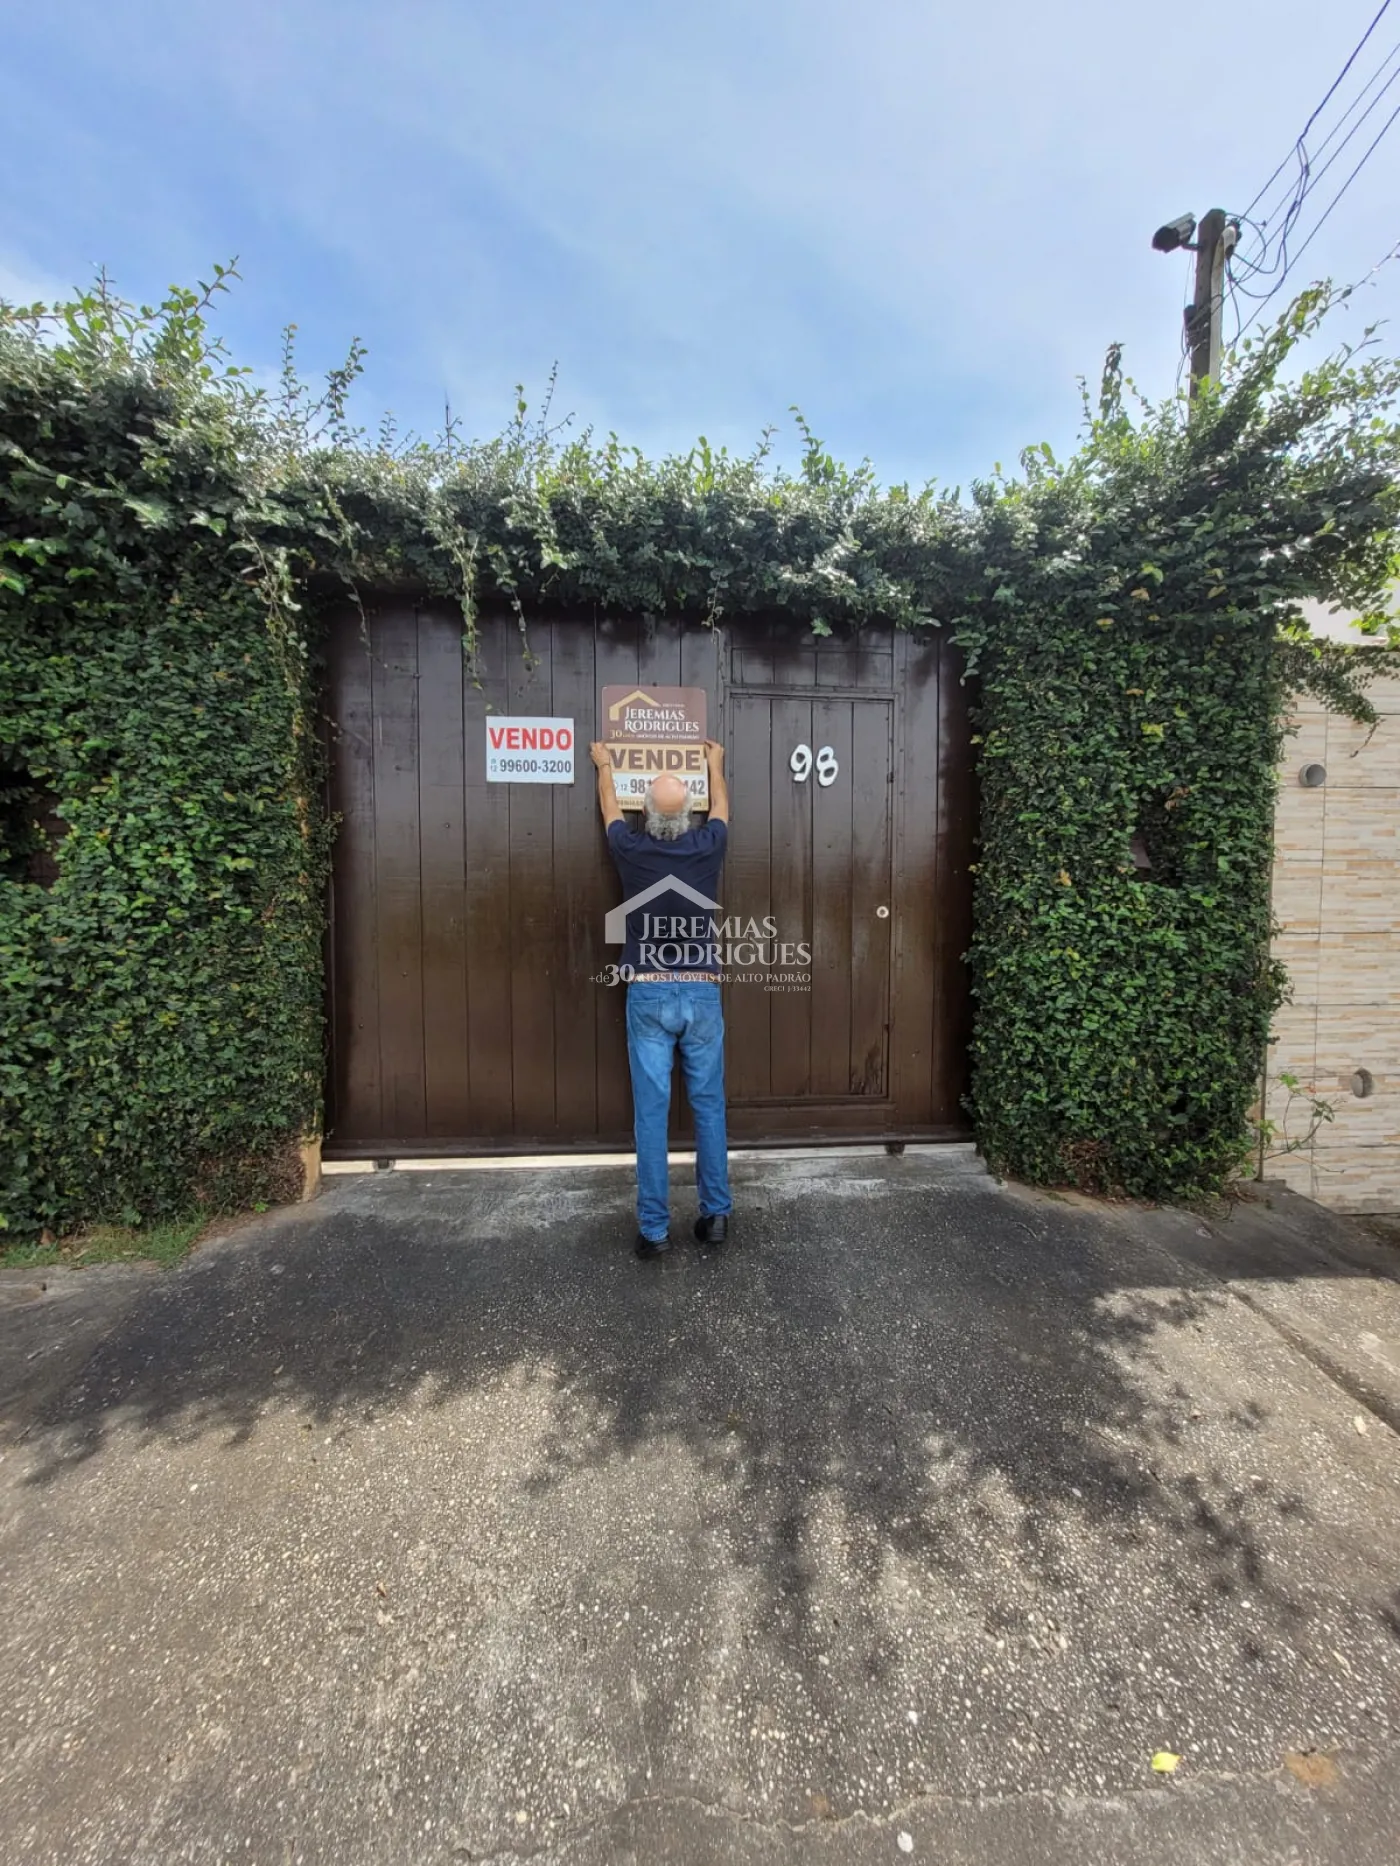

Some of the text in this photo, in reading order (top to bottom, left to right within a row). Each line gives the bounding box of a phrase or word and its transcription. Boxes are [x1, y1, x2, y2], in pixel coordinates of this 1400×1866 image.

[624, 706, 685, 721] JEREMIAS
[624, 720, 700, 733] RODRIGUES
[488, 727, 572, 751] VENDO
[500, 759, 572, 773] 99600-3200
[609, 749, 701, 770] VENDE
[790, 744, 839, 787] 98
